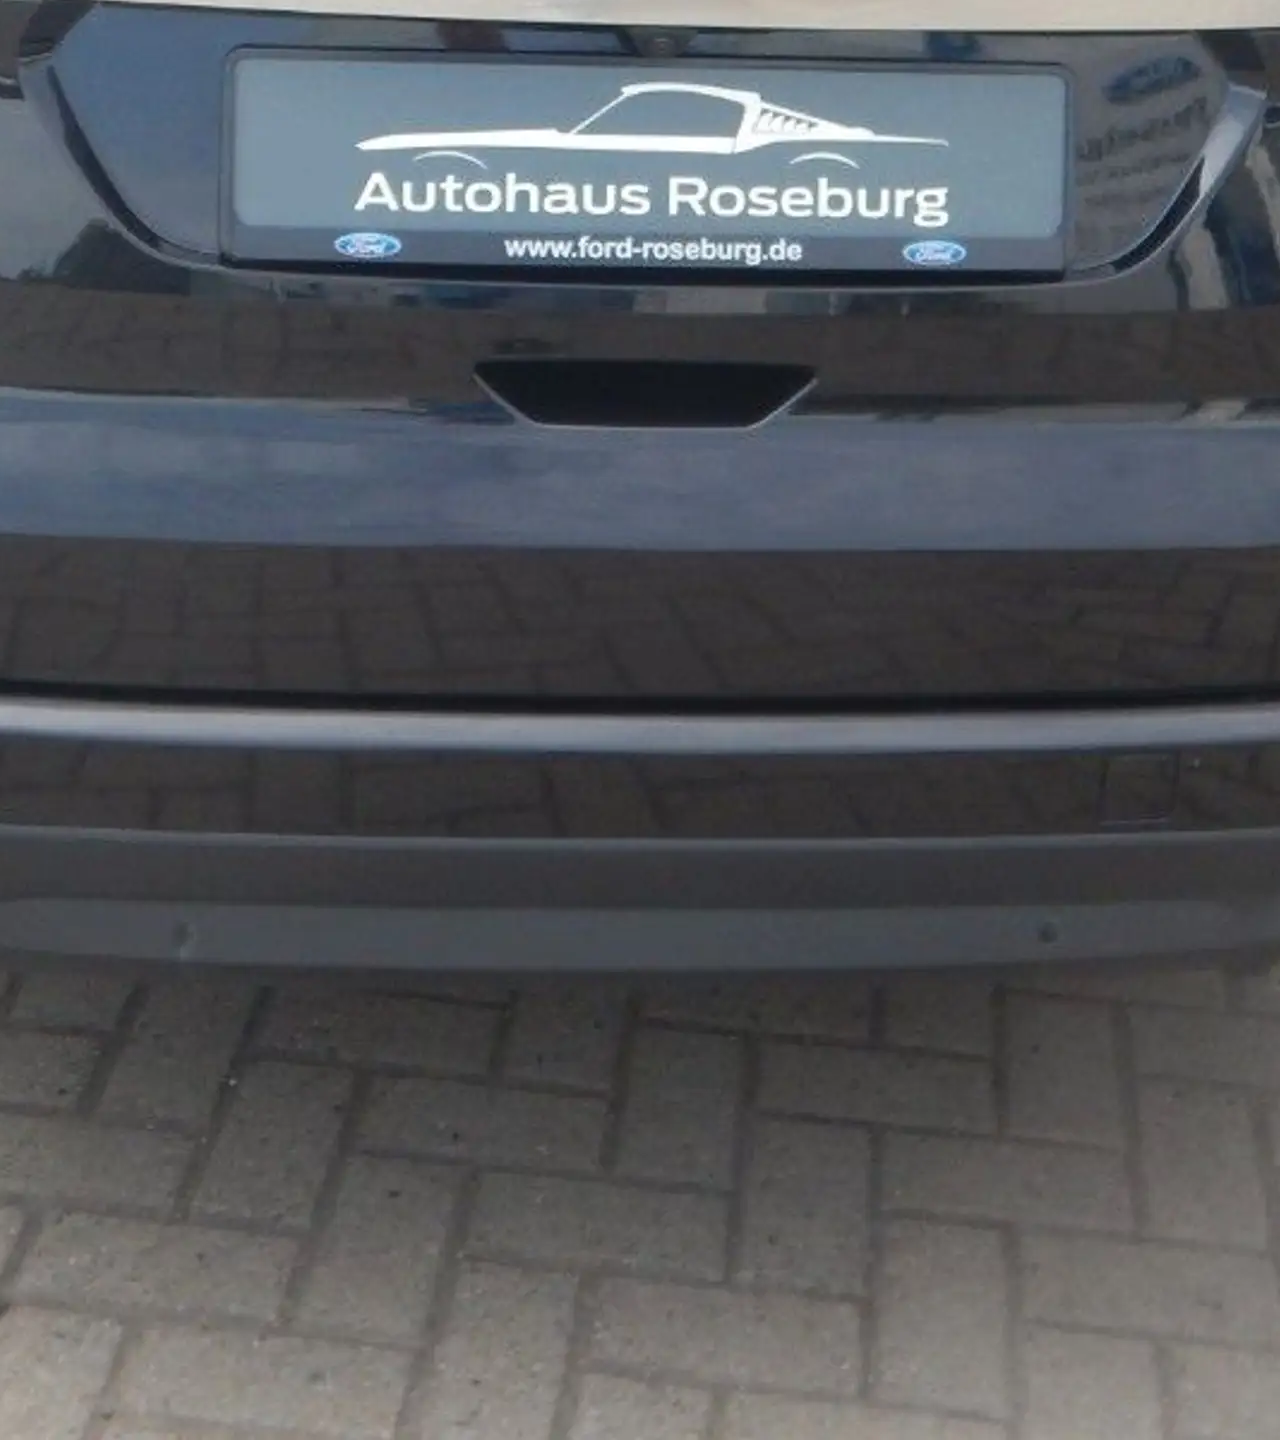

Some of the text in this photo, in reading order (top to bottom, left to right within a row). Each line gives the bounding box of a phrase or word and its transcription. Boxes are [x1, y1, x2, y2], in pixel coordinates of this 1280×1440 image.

[353, 172, 950, 228] Autohaus Roseburg
[504, 235, 803, 266] www.ford-roseburg.de
